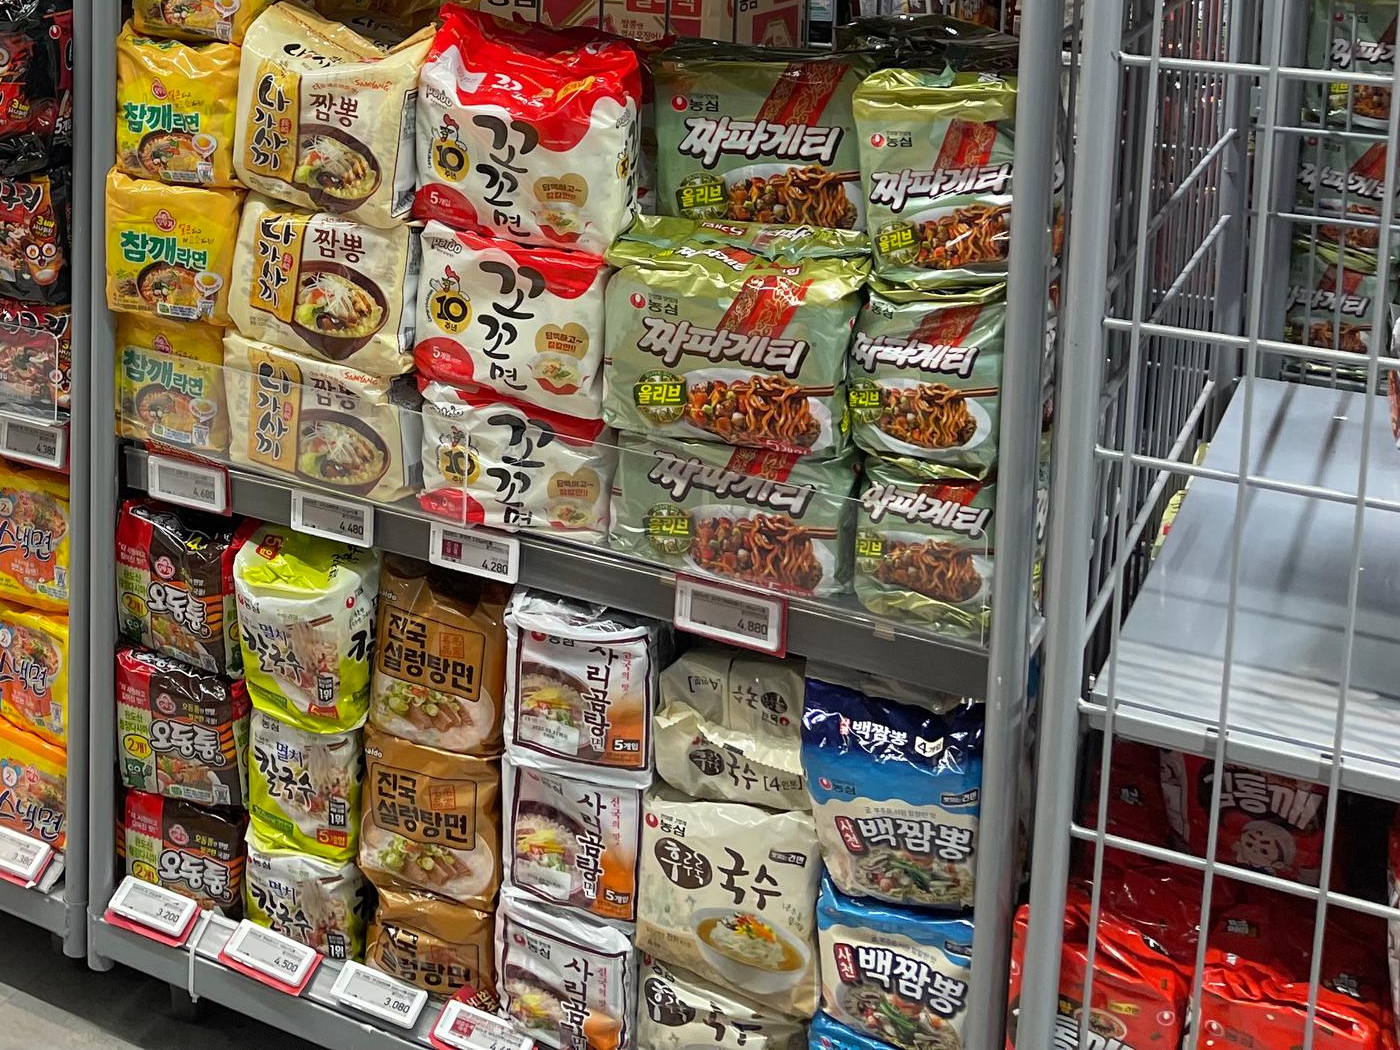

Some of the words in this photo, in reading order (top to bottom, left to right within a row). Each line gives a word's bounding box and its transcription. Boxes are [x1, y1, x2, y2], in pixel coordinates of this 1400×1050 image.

[122, 102, 200, 133] 참깨라면
[309, 93, 360, 128] 짬뽕
[689, 99, 720, 113] 농심
[679, 117, 843, 166] 짜파게티
[681, 185, 724, 208] 올리브
[871, 163, 1012, 211] 짜파게티
[120, 231, 209, 270] 참깨라면
[313, 225, 367, 265] 짬뽕
[432, 238, 462, 254] paldo
[878, 229, 915, 252] 올리브
[637, 317, 810, 377] 짜파게티
[852, 332, 980, 377] 짜파게티
[123, 350, 204, 393] 참깨라면
[637, 384, 681, 405] 올리브
[35, 444, 57, 458] 4.380
[650, 450, 816, 516] 짜파게티
[861, 482, 993, 539] 짜파게티
[339, 523, 364, 536] 4.480
[648, 516, 689, 535] 올리브
[482, 560, 508, 575] 4.280
[259, 623, 289, 644] 멸치
[389, 613, 428, 646] 진국
[737, 620, 769, 636] 4.880
[242, 623, 306, 686] 칼국수
[383, 640, 474, 694] 설렁탕면
[613, 739, 639, 752] 5개입
[852, 720, 909, 748] 백짬뽕
[276, 741, 304, 766] 멸치
[255, 745, 317, 809] 칼국수
[378, 771, 418, 805] 진국
[378, 802, 468, 844] 설렁탕면
[857, 816, 972, 862] 백짬뽕
[11, 852, 34, 867] 3.380
[267, 879, 297, 906] 멸치
[717, 846, 783, 911] 국수
[605, 891, 631, 905] 5개입
[156, 907, 180, 924] 3.200
[274, 957, 299, 974] 4.500
[836, 946, 855, 980] 사천
[857, 945, 967, 1017] 백짬뽕
[383, 997, 411, 1014] 3.080
